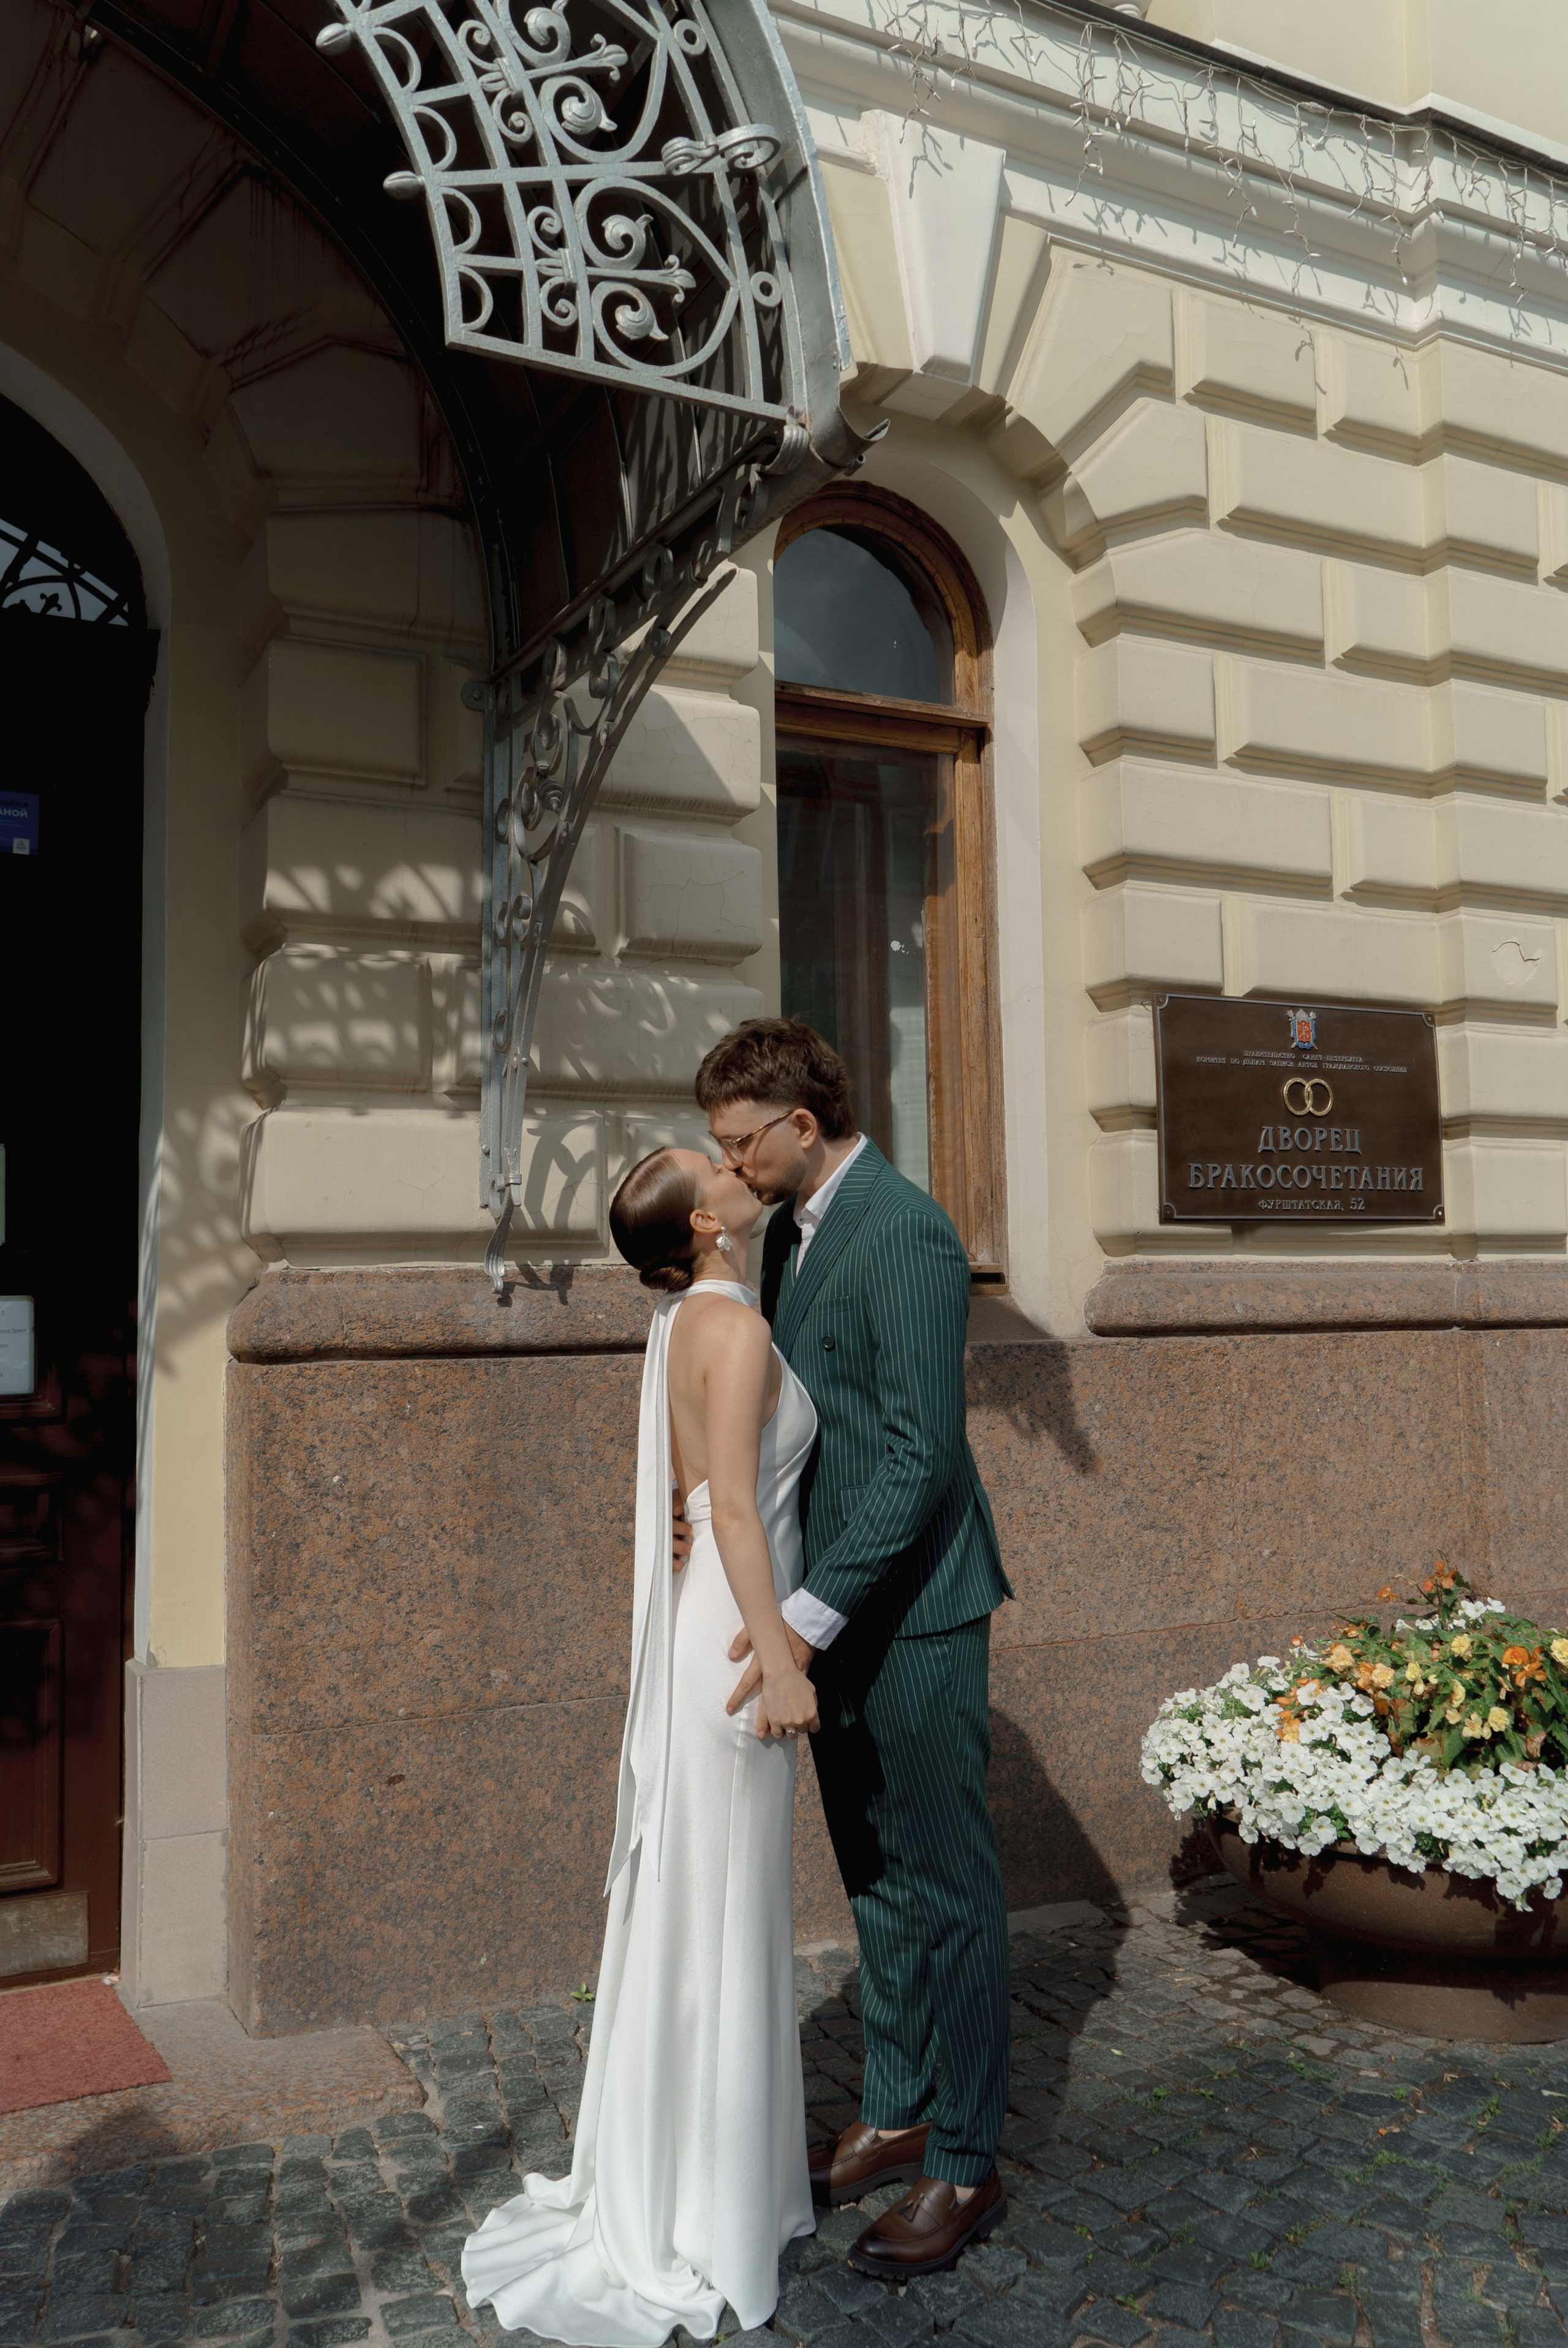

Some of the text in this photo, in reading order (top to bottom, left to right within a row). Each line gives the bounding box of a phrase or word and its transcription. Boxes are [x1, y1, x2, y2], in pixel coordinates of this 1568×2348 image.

[1243, 1050, 1364, 1063] ПРАВИТЕЛЬСТВО САНКТ-ПЕТЕРБУРГА
[1257, 1126, 1362, 1156] ДВОРЕЦ
[1188, 1163, 1424, 1191] БРАКОСОЧЕТАНИЯ
[1257, 1198, 1366, 1212] ФУРШТАТСКАЯ, 52
